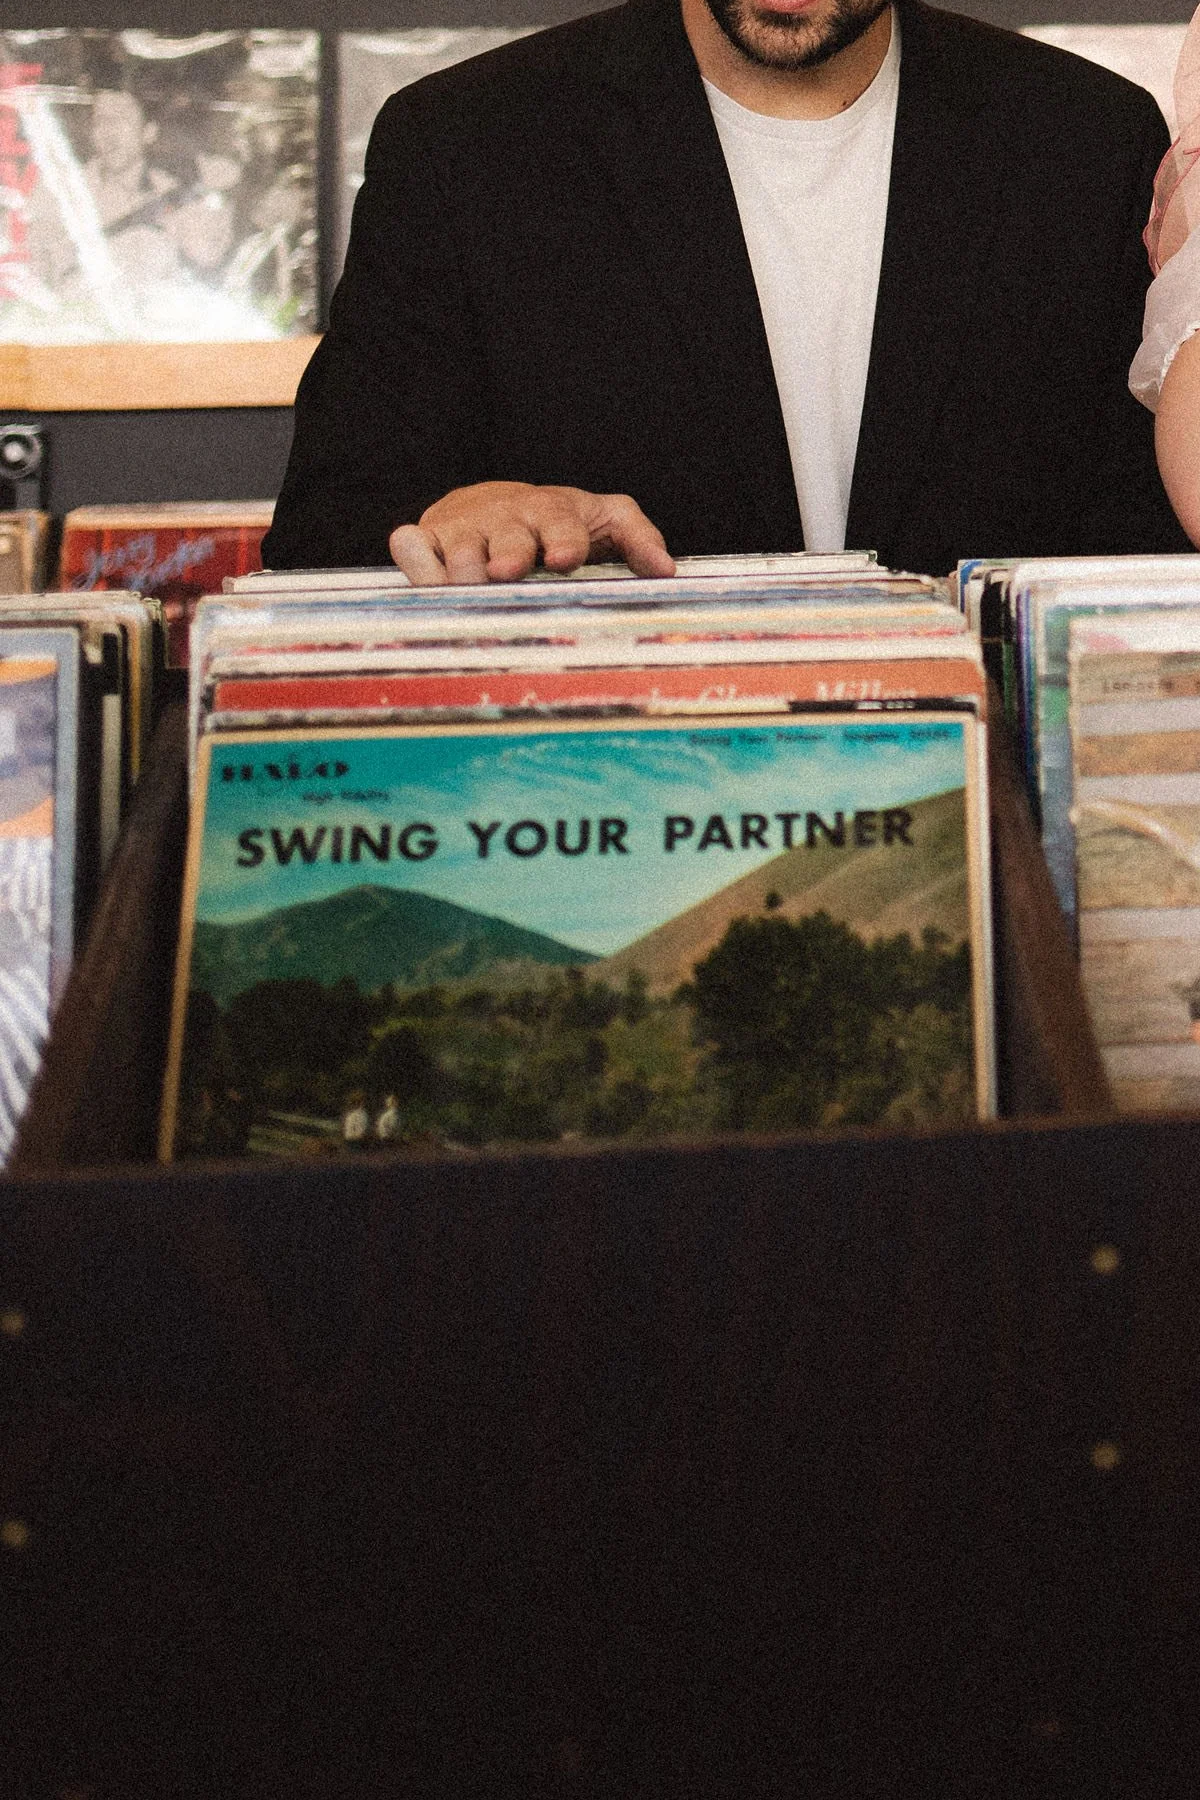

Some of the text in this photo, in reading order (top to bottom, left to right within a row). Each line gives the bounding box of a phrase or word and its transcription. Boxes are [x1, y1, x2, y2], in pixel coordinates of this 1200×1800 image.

[236, 809, 915, 868] SWING YOUR PARTNER
